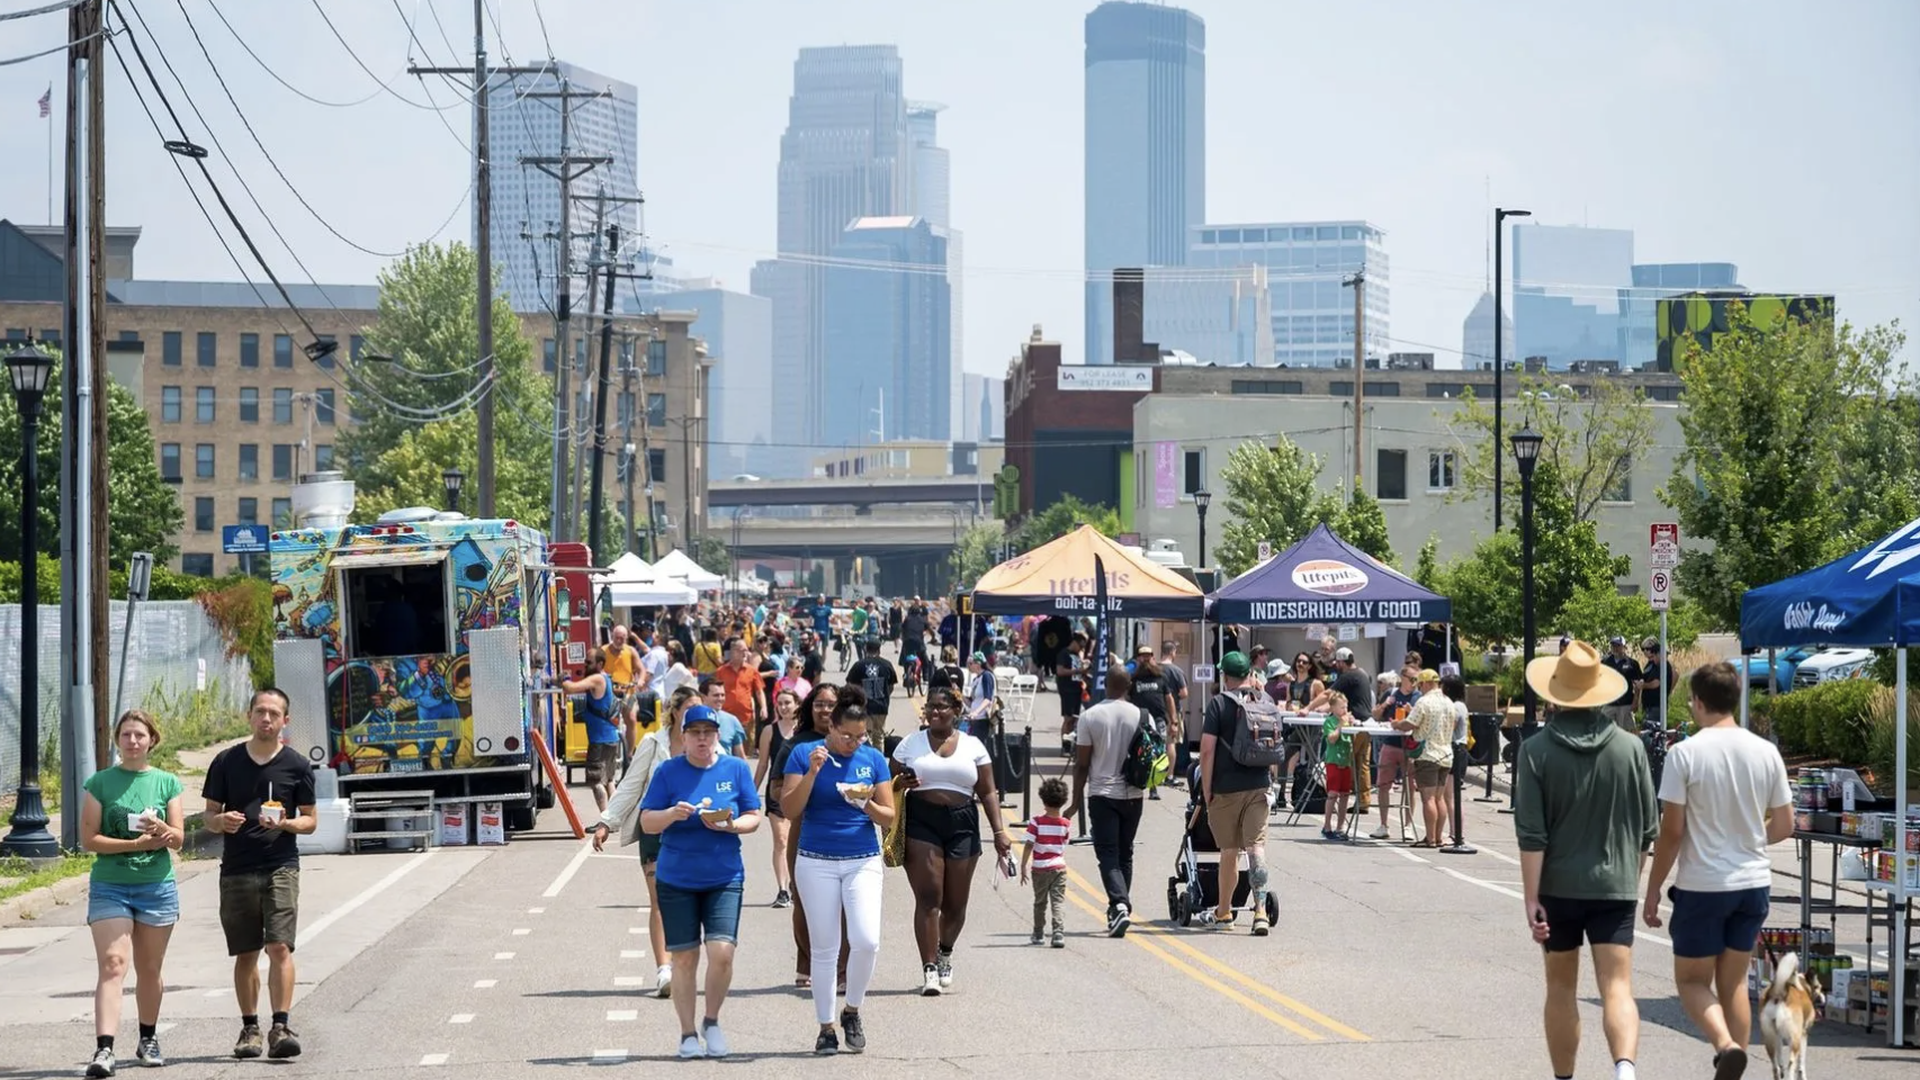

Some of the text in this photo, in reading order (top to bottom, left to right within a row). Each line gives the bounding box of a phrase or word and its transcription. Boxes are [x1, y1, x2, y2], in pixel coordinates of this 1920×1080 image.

[1049, 571, 1130, 595] Uteils
[1055, 596, 1122, 611] ooh-ta-ilz
[1250, 601, 1421, 620] INDESCRIBABLY GOOD
[855, 766, 872, 776] LSE
[716, 781, 733, 791] LSE
